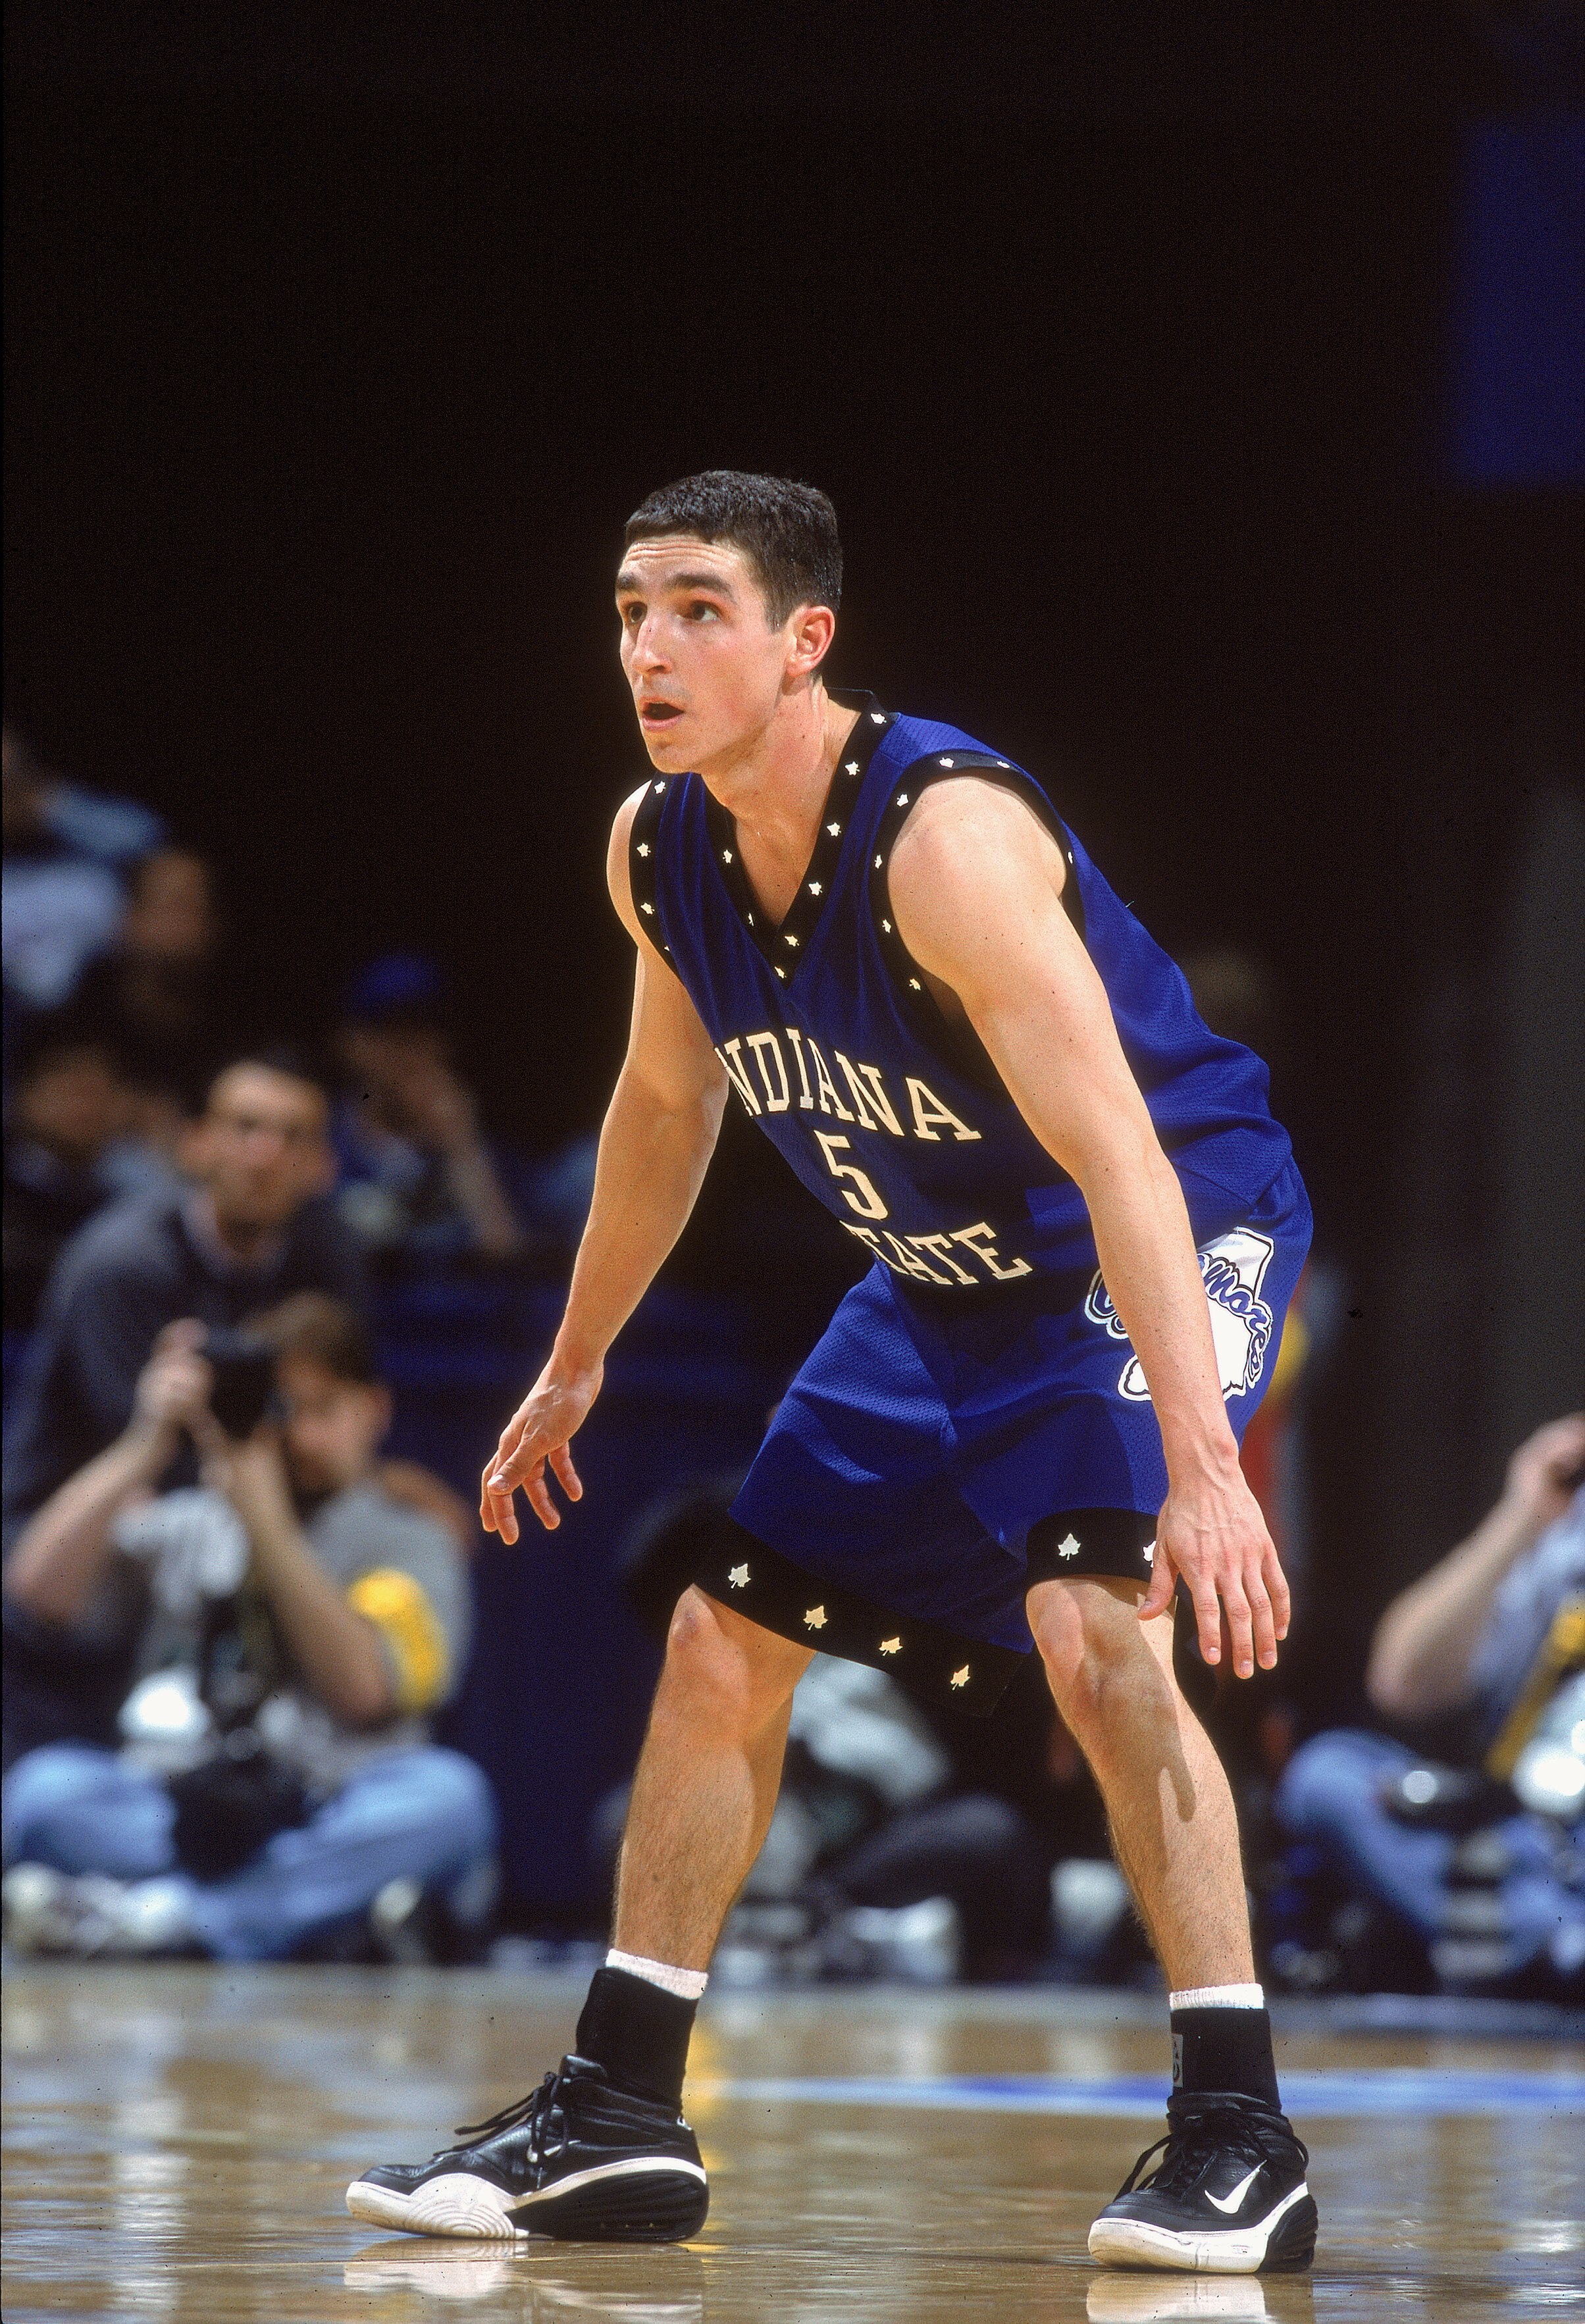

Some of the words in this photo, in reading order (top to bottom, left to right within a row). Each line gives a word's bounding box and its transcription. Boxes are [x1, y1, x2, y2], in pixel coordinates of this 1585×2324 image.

[714, 1028, 982, 1141] NDIANA
[814, 1130, 888, 1220] 5
[839, 1221, 1033, 1285] TATE
